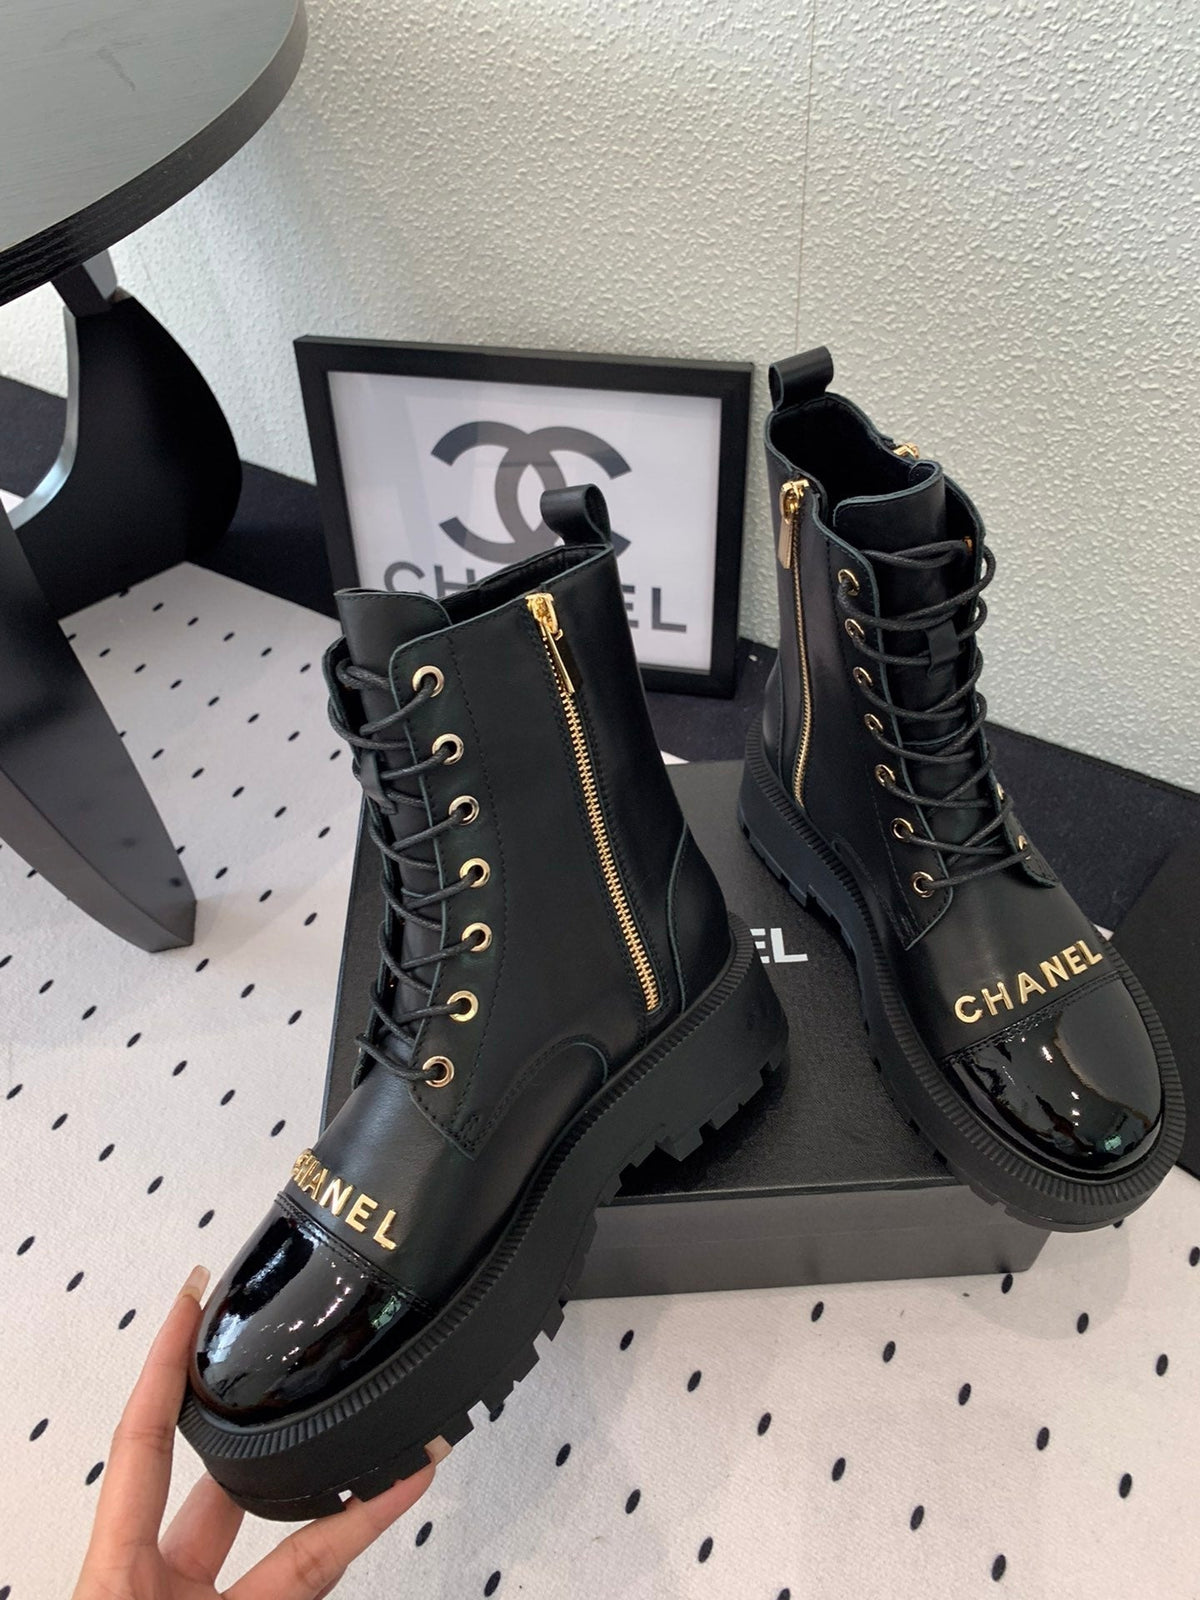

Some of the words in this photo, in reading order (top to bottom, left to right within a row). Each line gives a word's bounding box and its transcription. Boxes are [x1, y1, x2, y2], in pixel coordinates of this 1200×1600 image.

[383, 561, 687, 634] CHL
[954, 939, 1104, 1024] CHANEL
[291, 1148, 398, 1250] CHANEL
